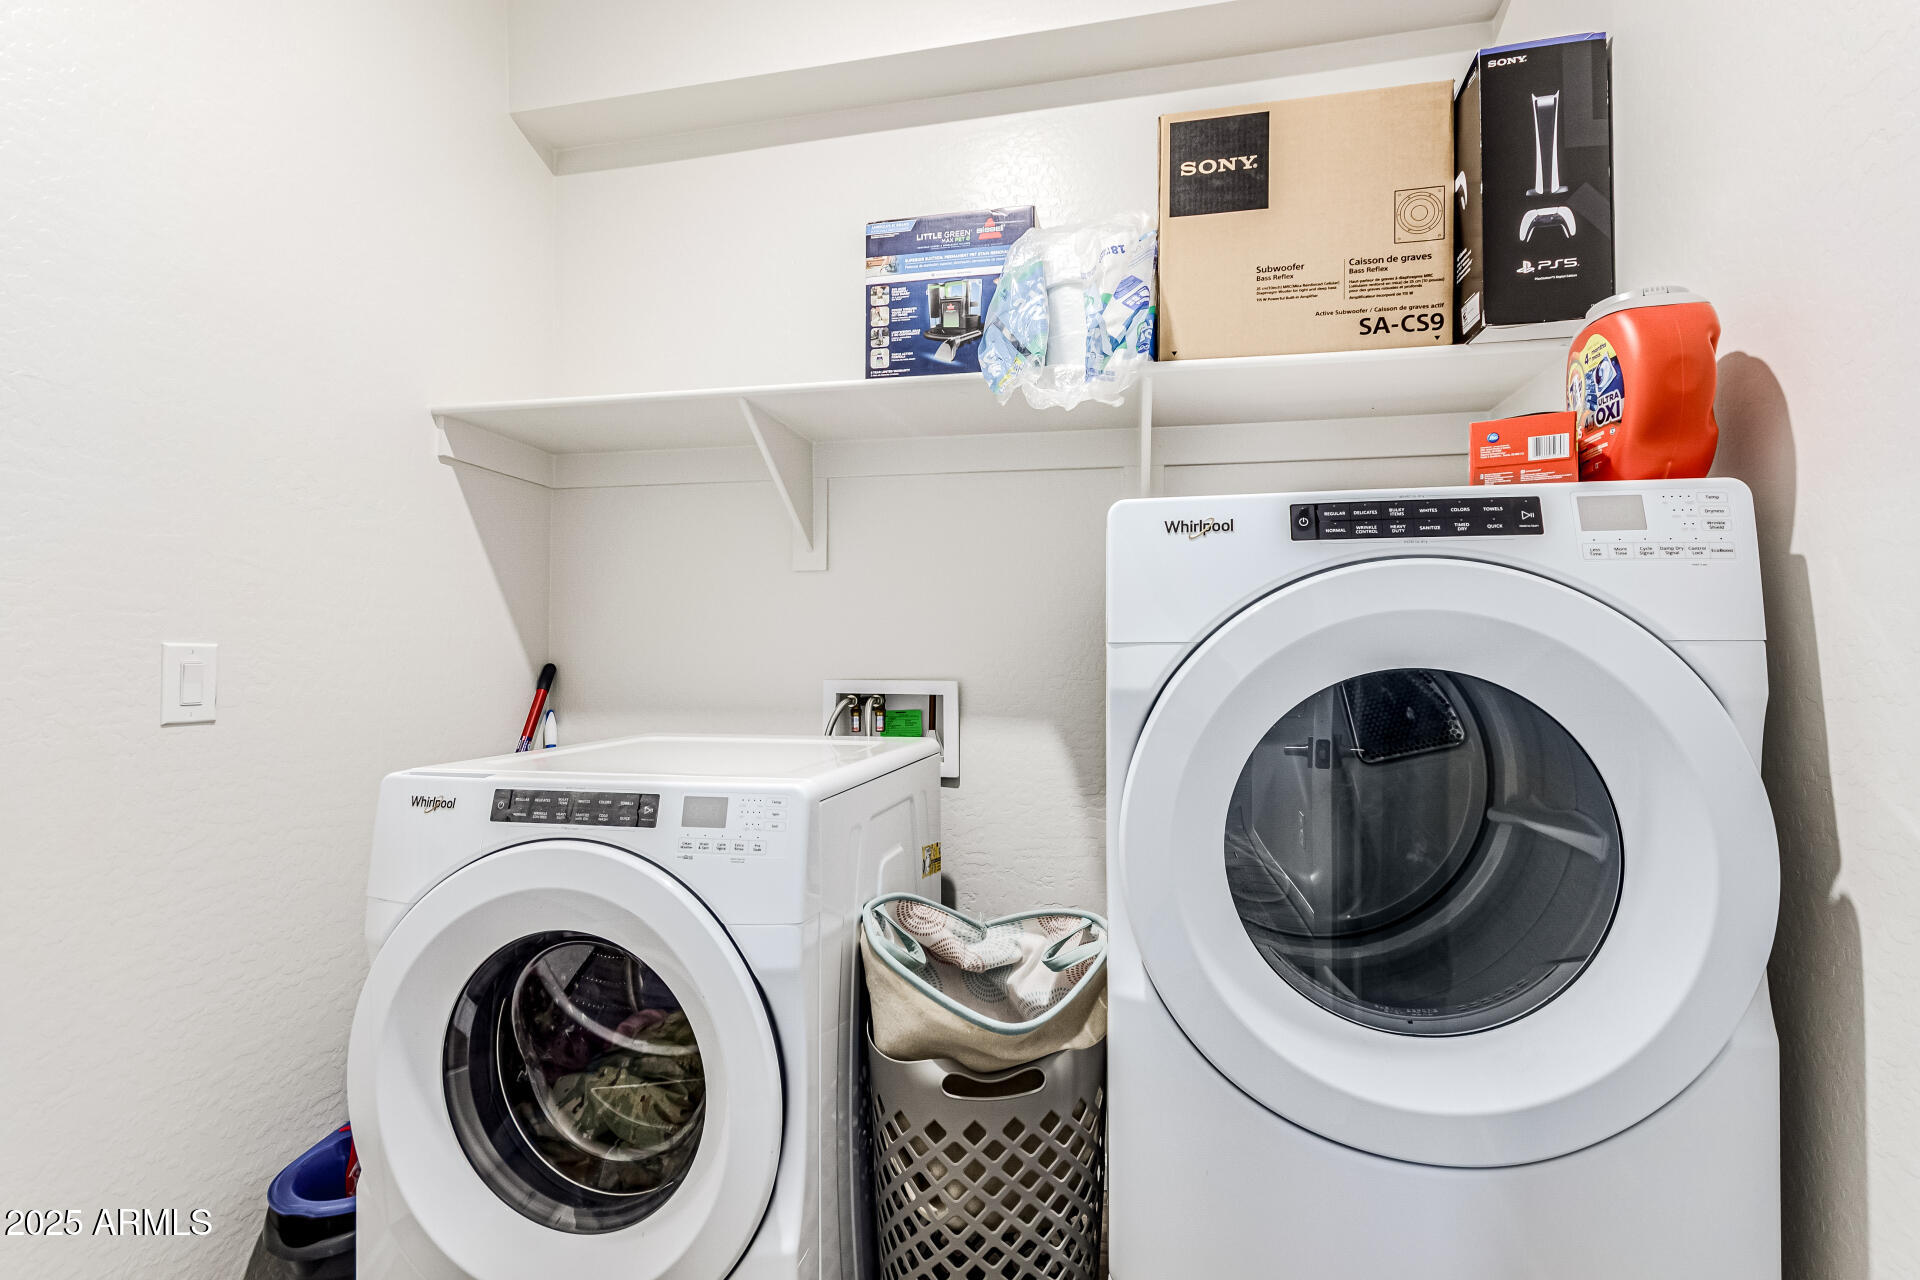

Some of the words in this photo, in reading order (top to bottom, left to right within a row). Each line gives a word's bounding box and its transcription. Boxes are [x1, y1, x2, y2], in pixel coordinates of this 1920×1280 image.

[916, 232, 942, 241] LITTLE
[944, 229, 971, 238] GREEN
[1401, 253, 1432, 263] graves
[1538, 257, 1577, 270] PS5
[1256, 263, 1304, 274] Subwoofer
[1360, 313, 1444, 335] SA-CS9
[1598, 391, 1619, 406] ULTRA
[1596, 400, 1620, 426] OXI
[1164, 518, 1234, 536] Whirlpool
[412, 795, 456, 811] Whirlpool
